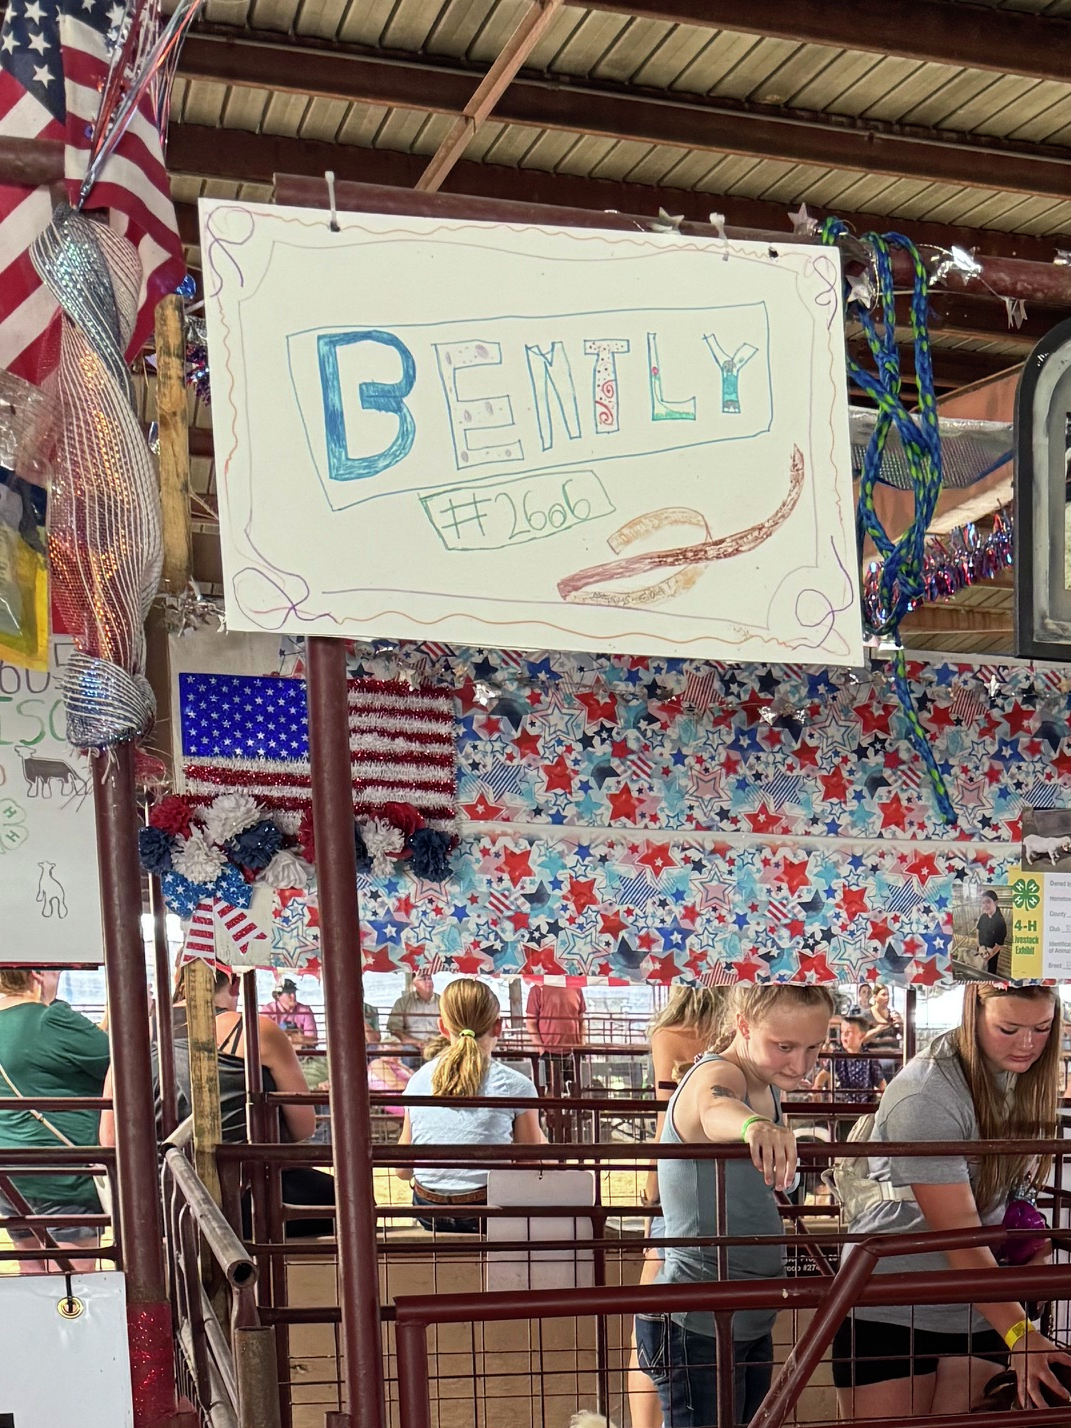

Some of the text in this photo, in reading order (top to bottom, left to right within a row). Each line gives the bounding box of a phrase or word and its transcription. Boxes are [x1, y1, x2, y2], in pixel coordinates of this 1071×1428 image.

[316, 329, 759, 482] BENTLY
[439, 479, 592, 540] #2606
[1014, 920, 1037, 931] 4-H
